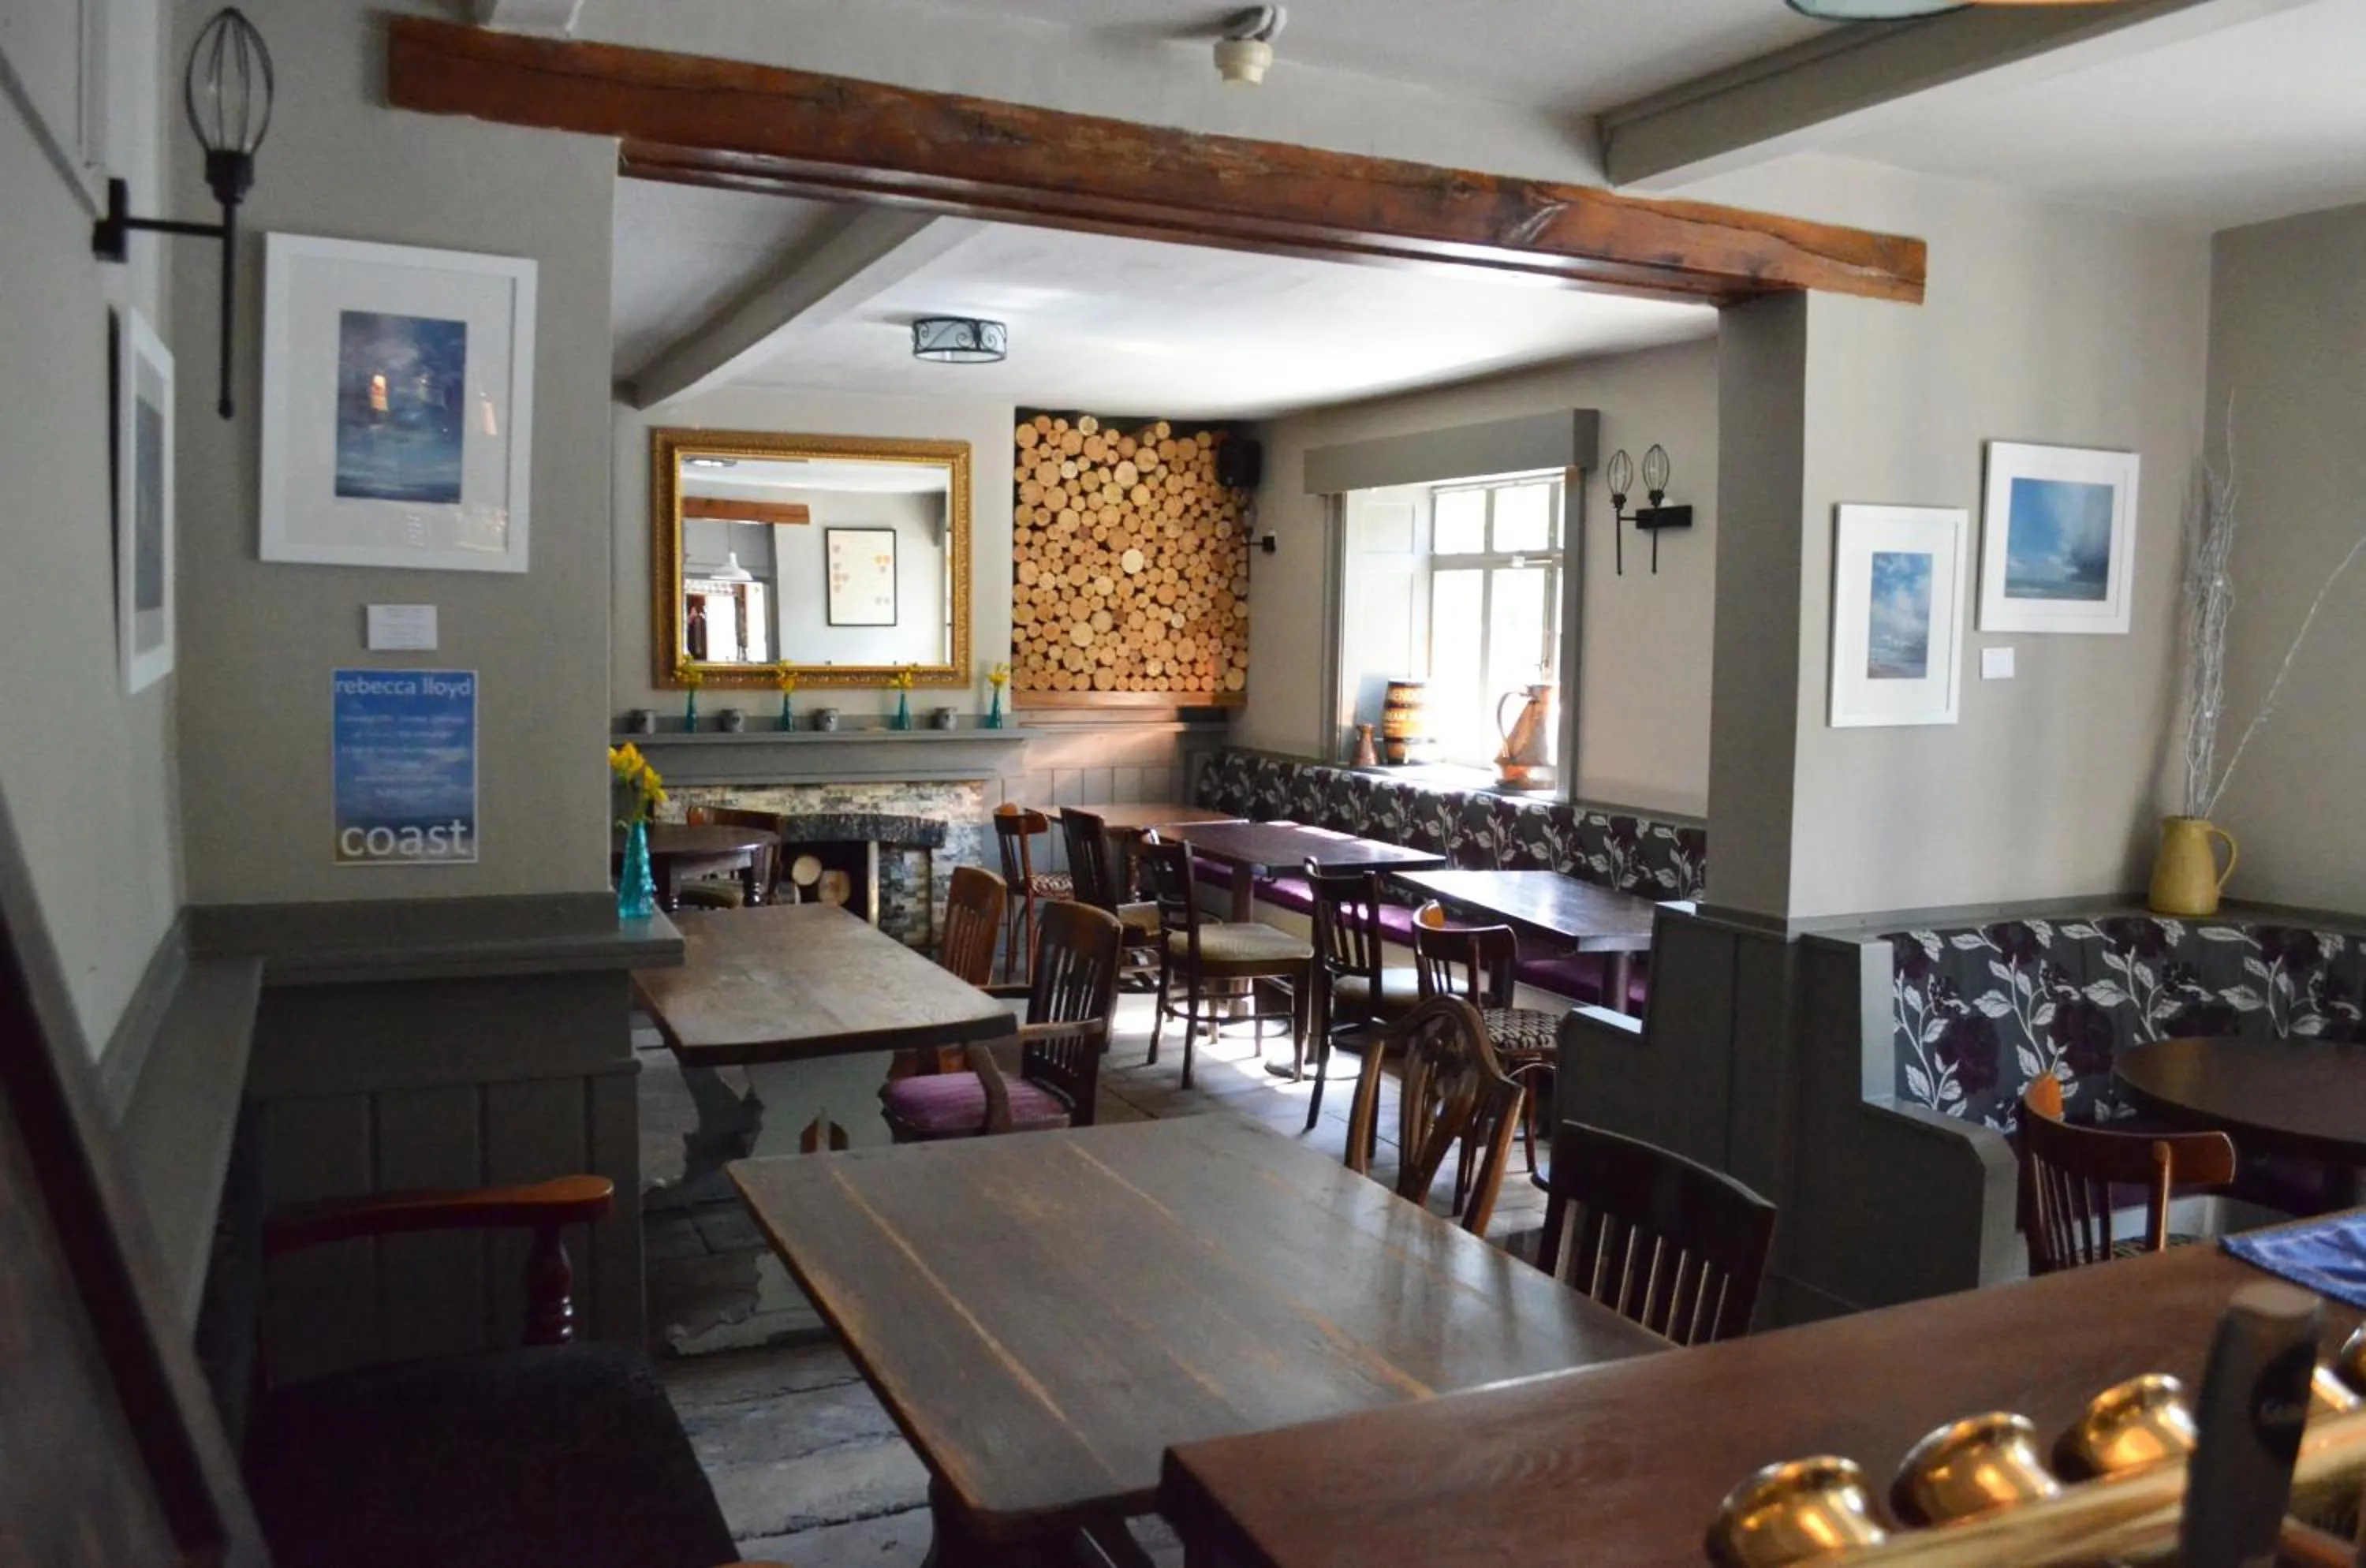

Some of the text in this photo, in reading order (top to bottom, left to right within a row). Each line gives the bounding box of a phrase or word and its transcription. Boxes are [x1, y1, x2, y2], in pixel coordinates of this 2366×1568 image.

[335, 675, 471, 700] rebecca lloyd
[341, 819, 470, 856] coast
